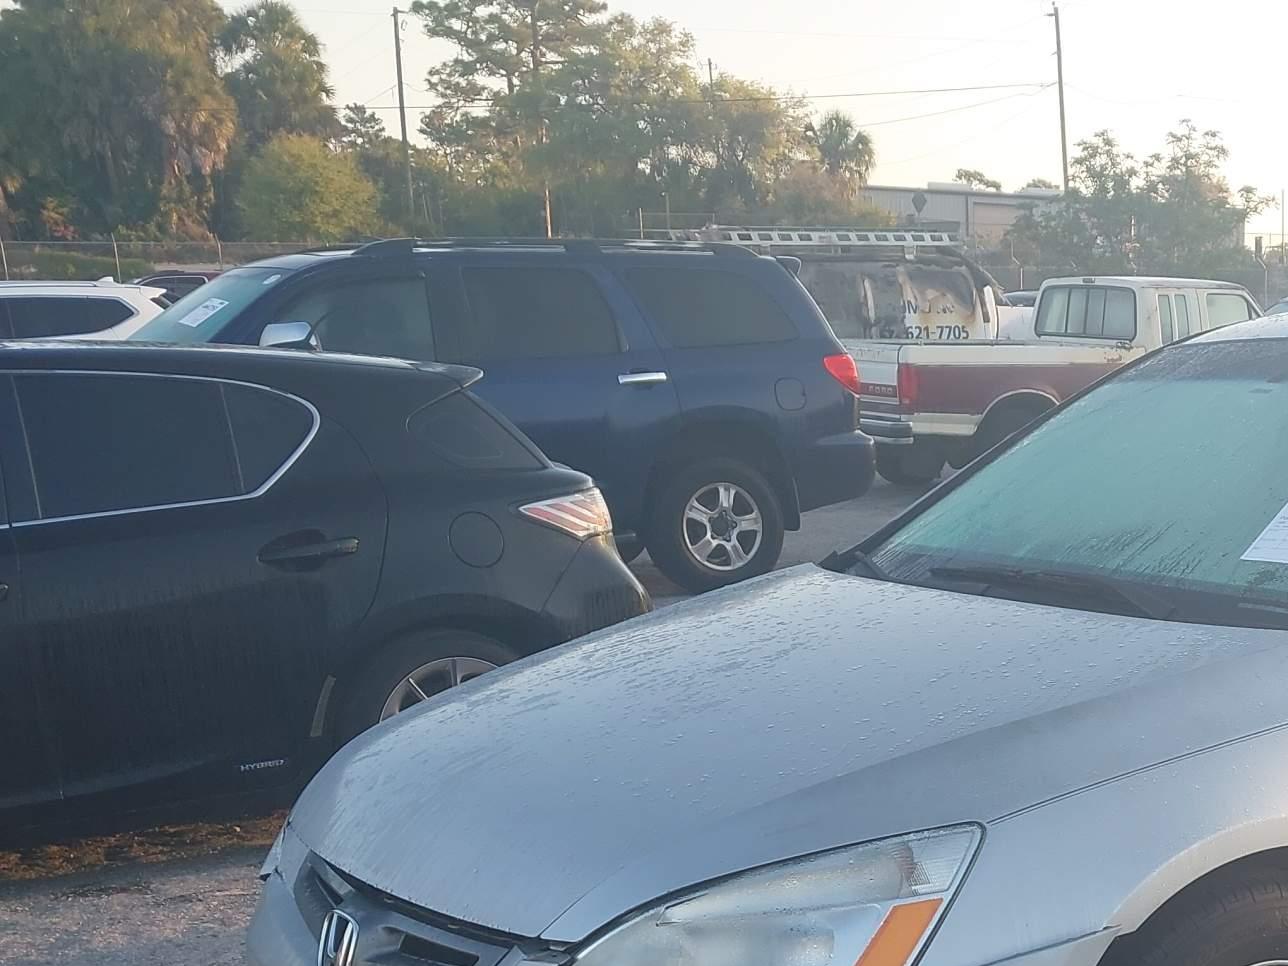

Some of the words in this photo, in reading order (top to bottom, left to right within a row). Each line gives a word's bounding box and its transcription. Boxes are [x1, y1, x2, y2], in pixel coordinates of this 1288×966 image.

[905, 325, 969, 339] 621-7705
[868, 385, 893, 394] FORD
[240, 759, 284, 772] HYBRID
